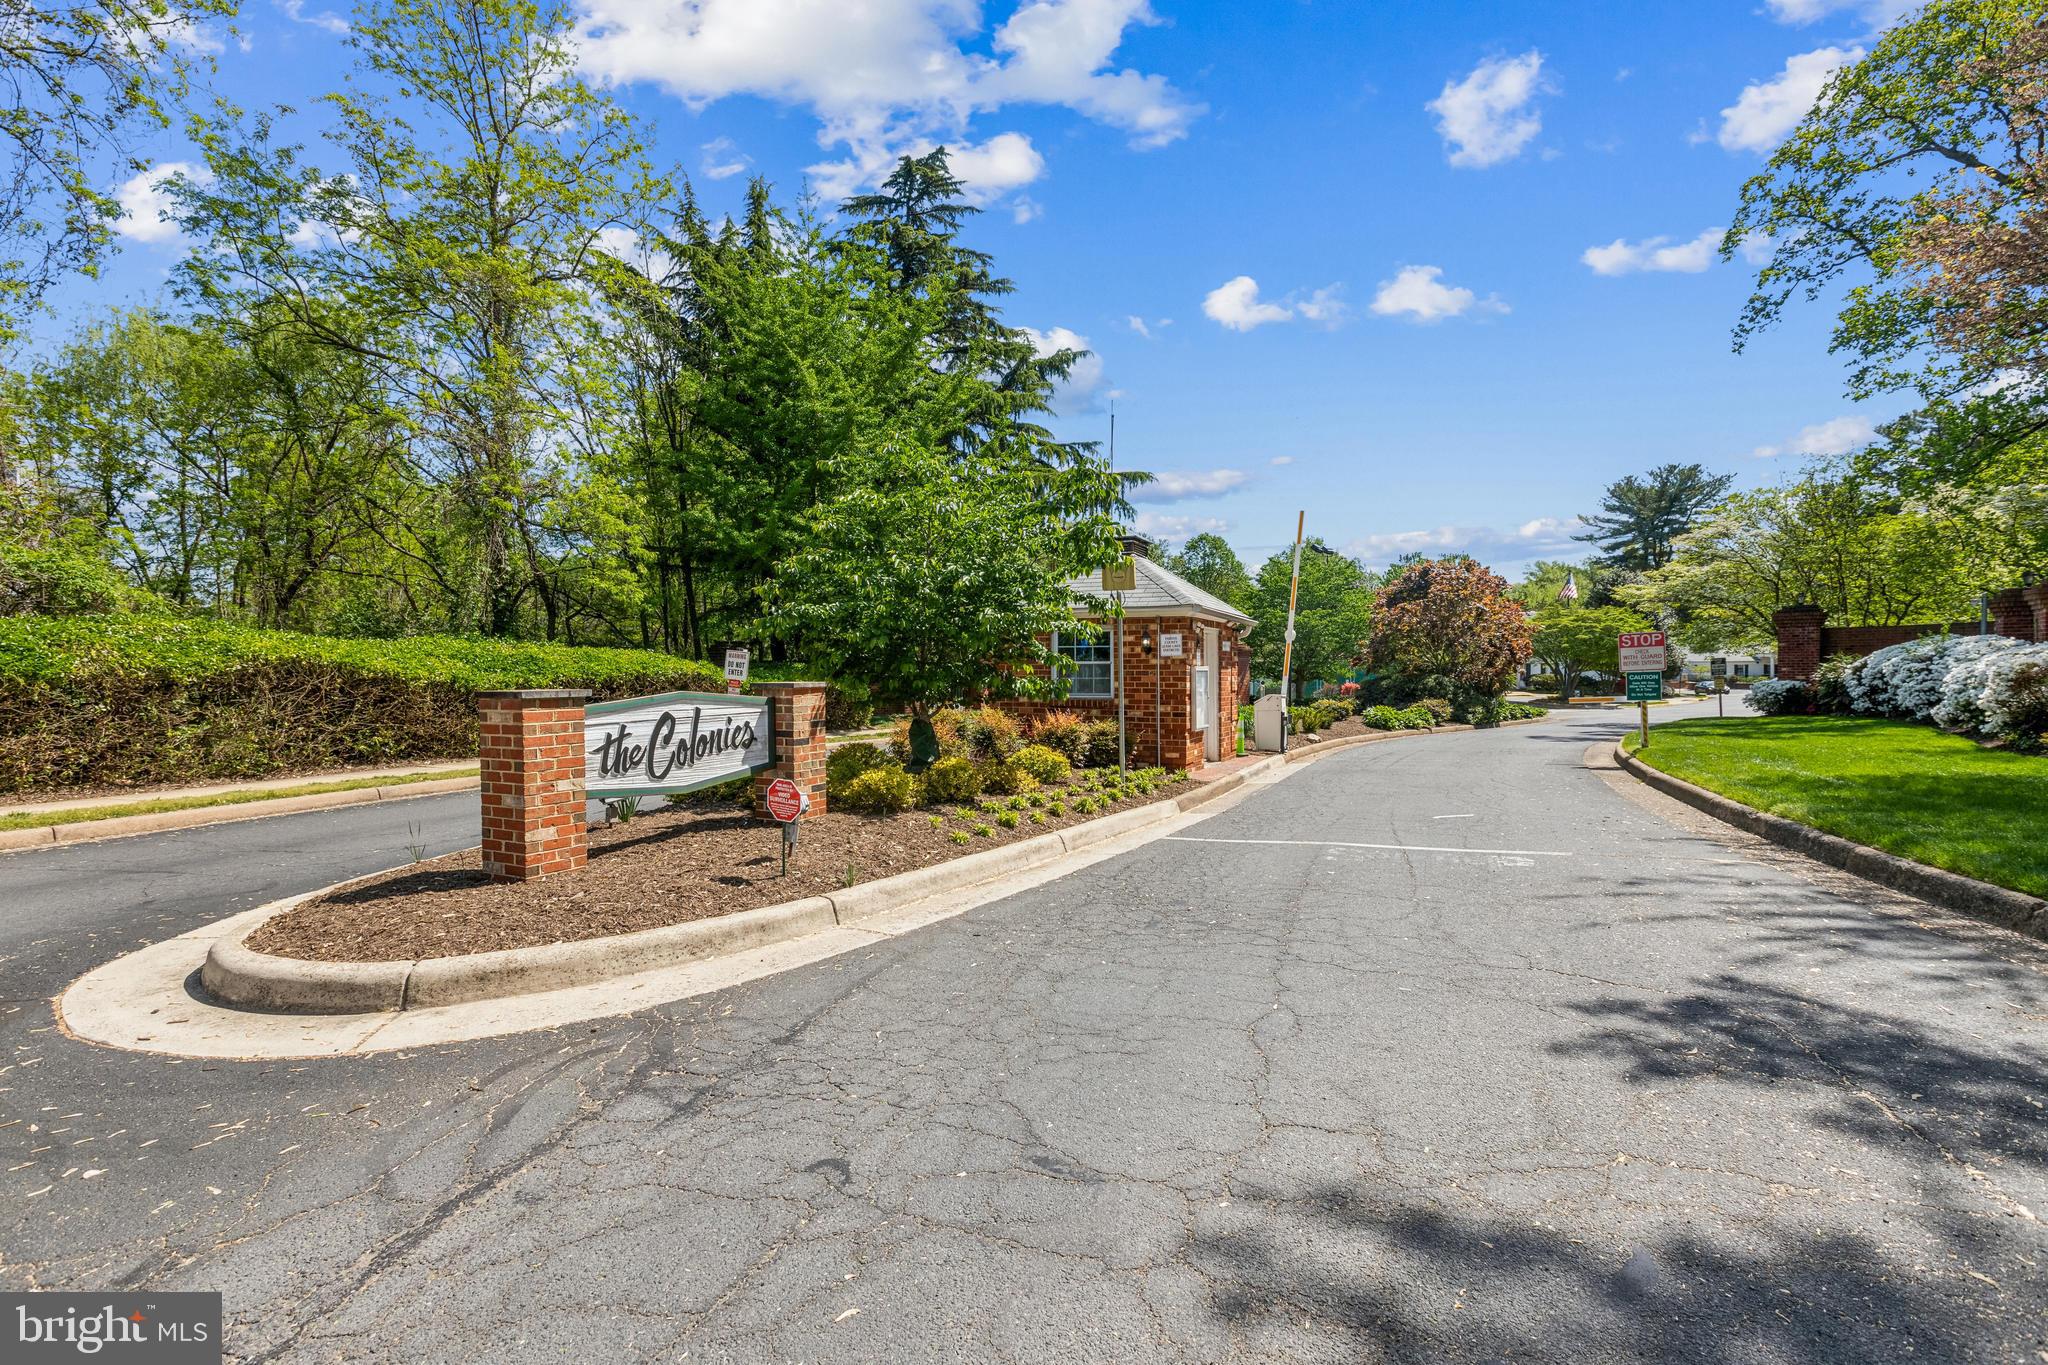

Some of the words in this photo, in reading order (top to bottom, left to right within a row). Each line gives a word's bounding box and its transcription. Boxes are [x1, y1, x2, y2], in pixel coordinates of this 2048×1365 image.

[1621, 634, 1662, 647] STOP
[735, 661, 745, 669] NOT
[587, 723, 647, 776] the
[647, 707, 758, 781] Colonies
